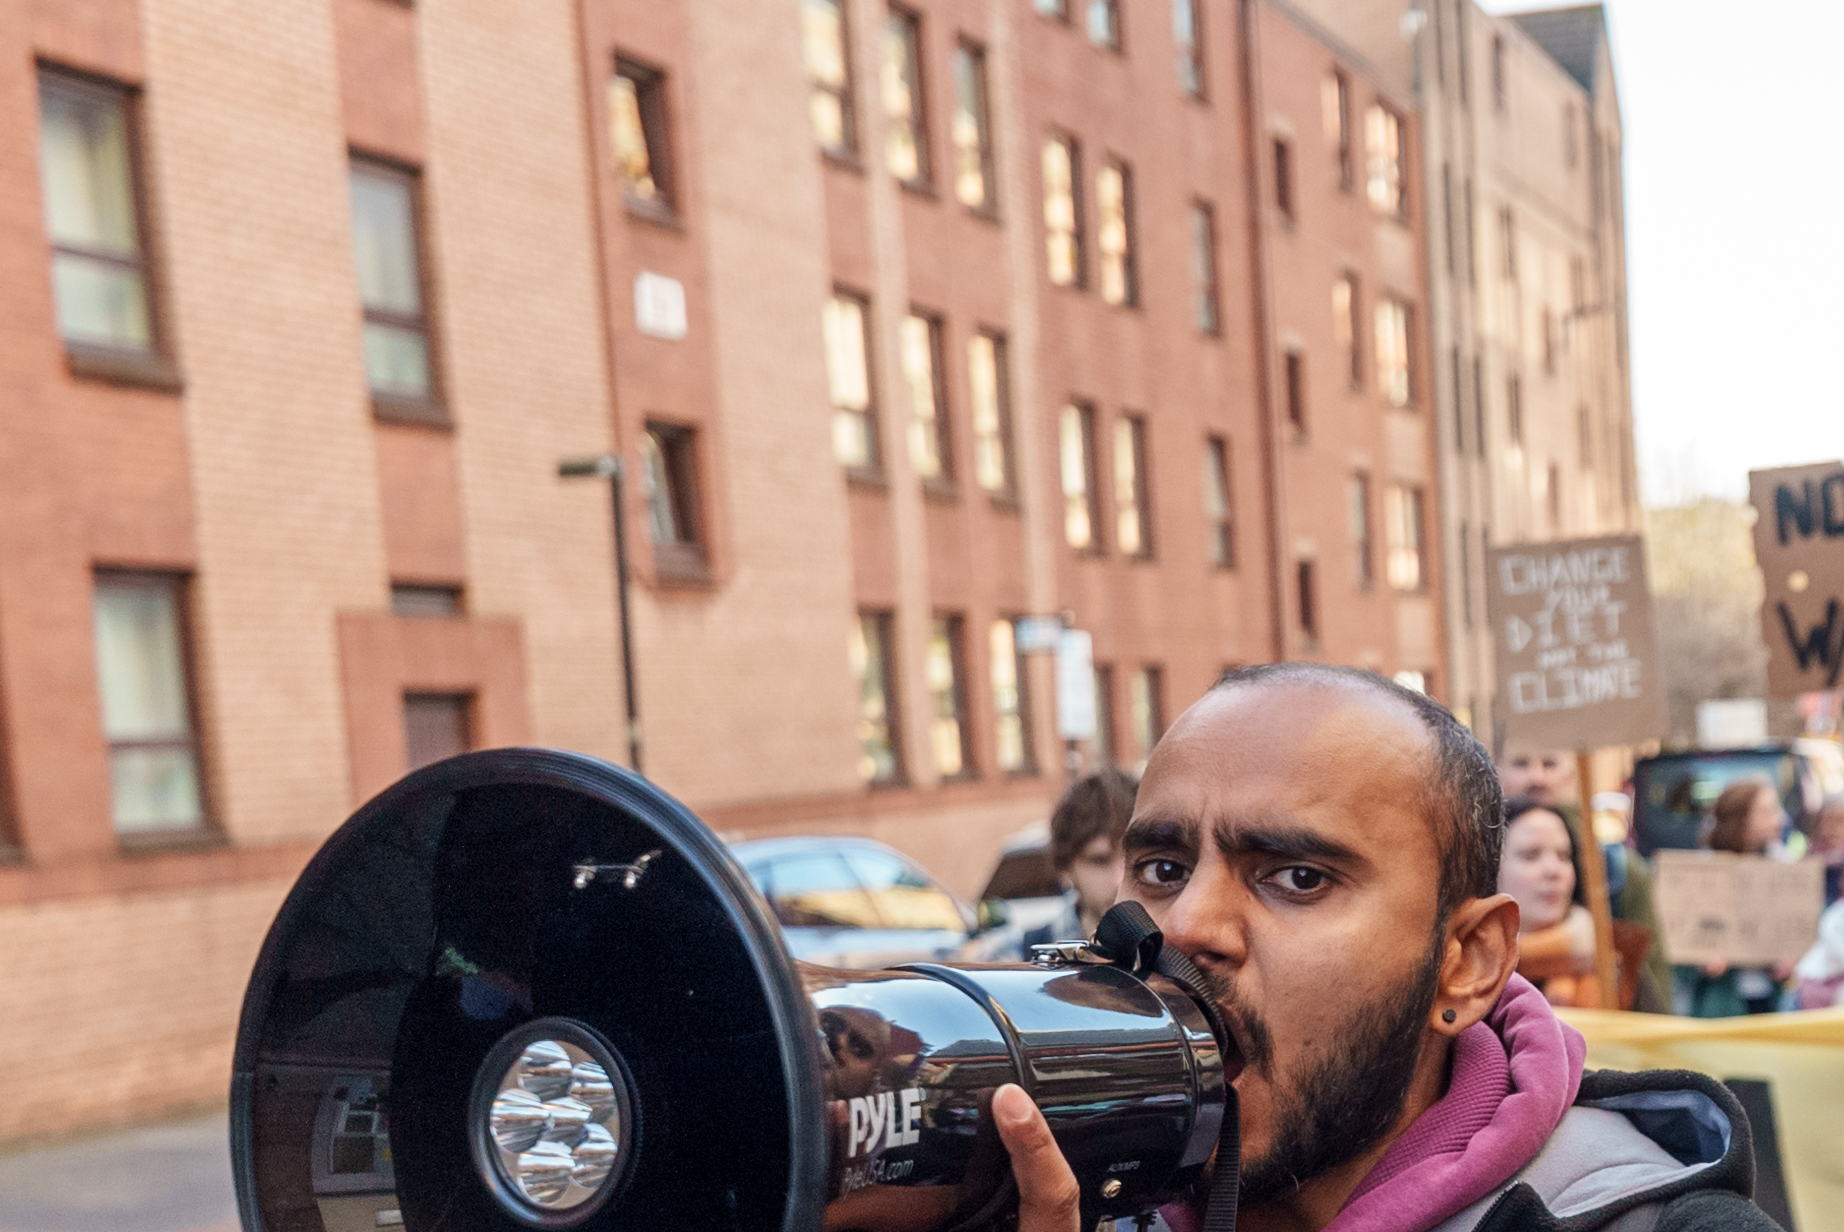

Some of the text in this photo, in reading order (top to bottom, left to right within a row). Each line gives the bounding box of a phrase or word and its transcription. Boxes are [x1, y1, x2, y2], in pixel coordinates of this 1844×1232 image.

[1499, 546, 1630, 596] CHANGE
[1505, 601, 1628, 654] DIET
[1508, 658, 1642, 713] CLIMATE
